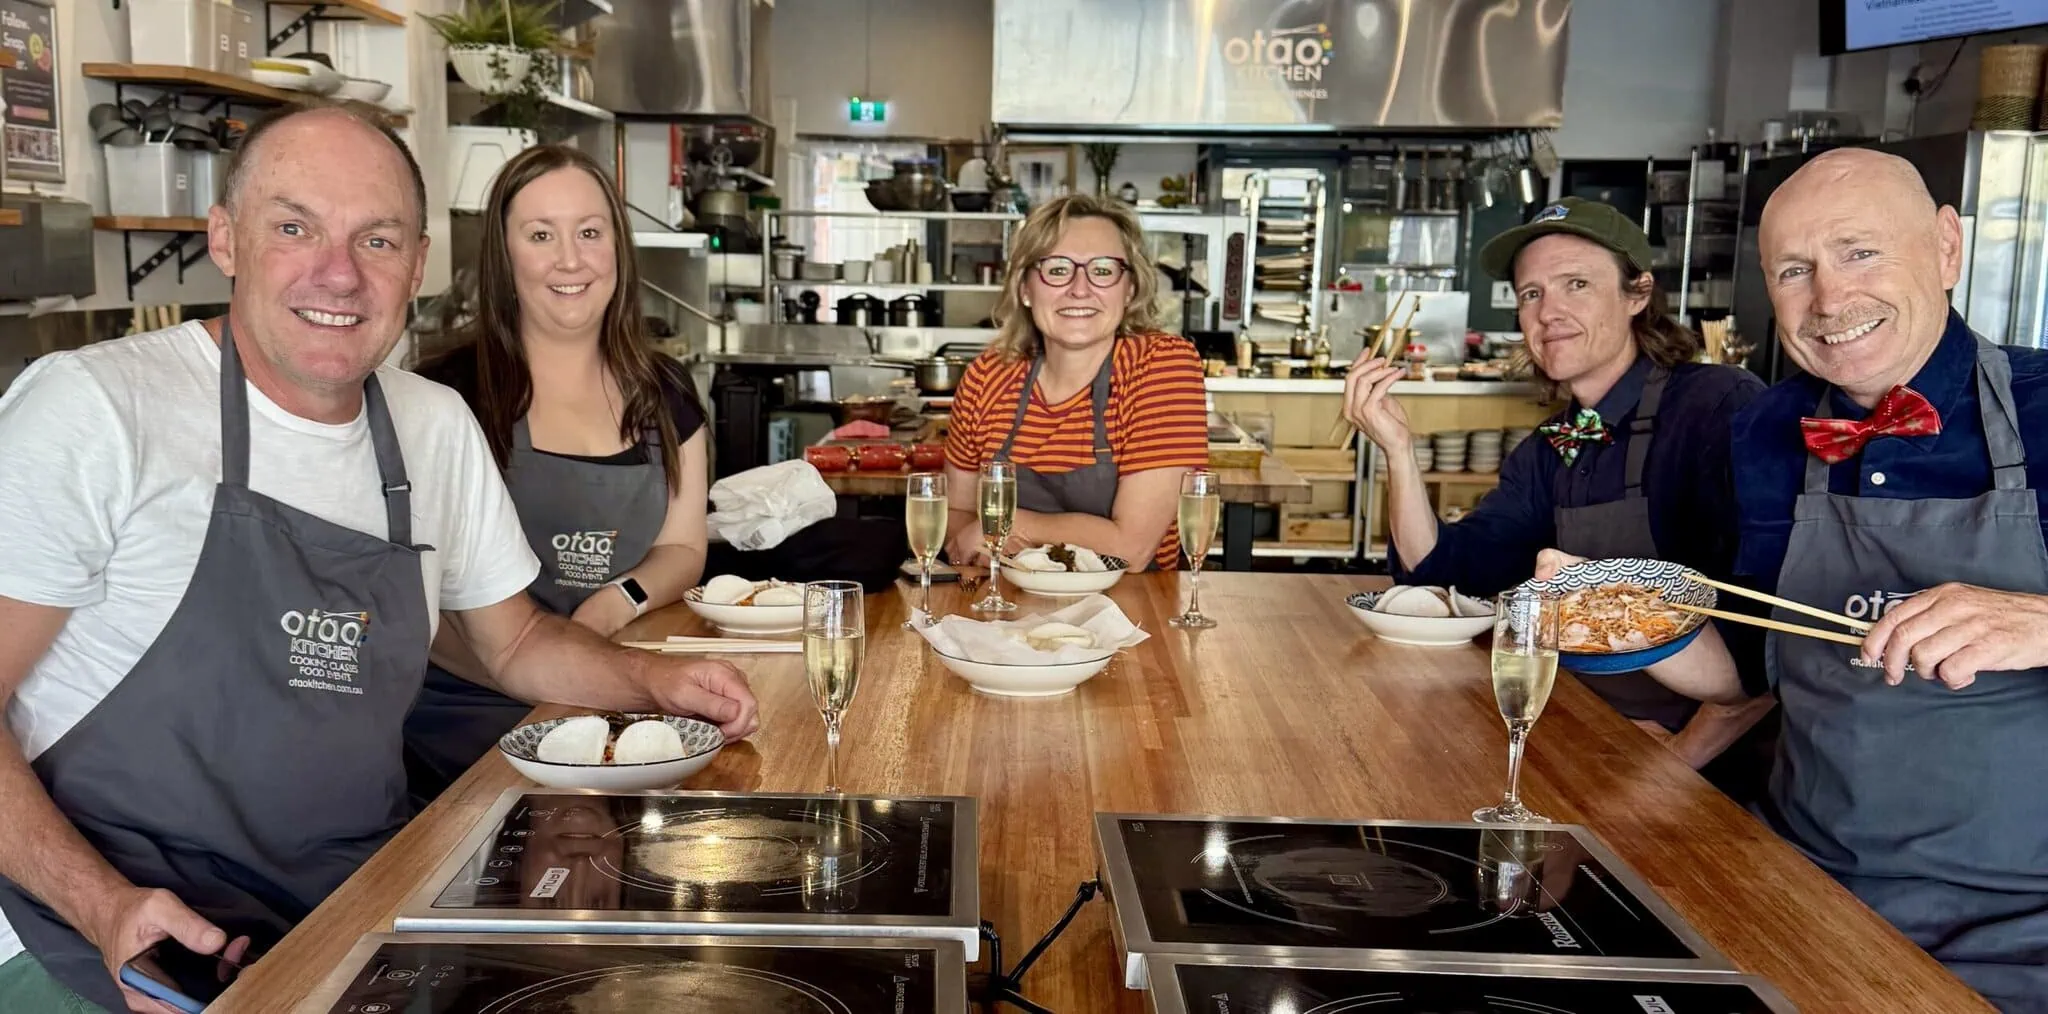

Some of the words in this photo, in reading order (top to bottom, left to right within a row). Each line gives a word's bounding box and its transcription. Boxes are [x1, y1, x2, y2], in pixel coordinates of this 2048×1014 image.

[1236, 64, 1323, 82] KITCHEN
[557, 551, 611, 567] KITCHEN
[290, 637, 359, 664] KITCHEN
[289, 655, 328, 669] COOKING
[328, 661, 359, 674] CLASSES
[299, 665, 326, 678] FOOD
[326, 669, 352, 682] EVENTS
[288, 678, 364, 695] otaokitchen.com.au
